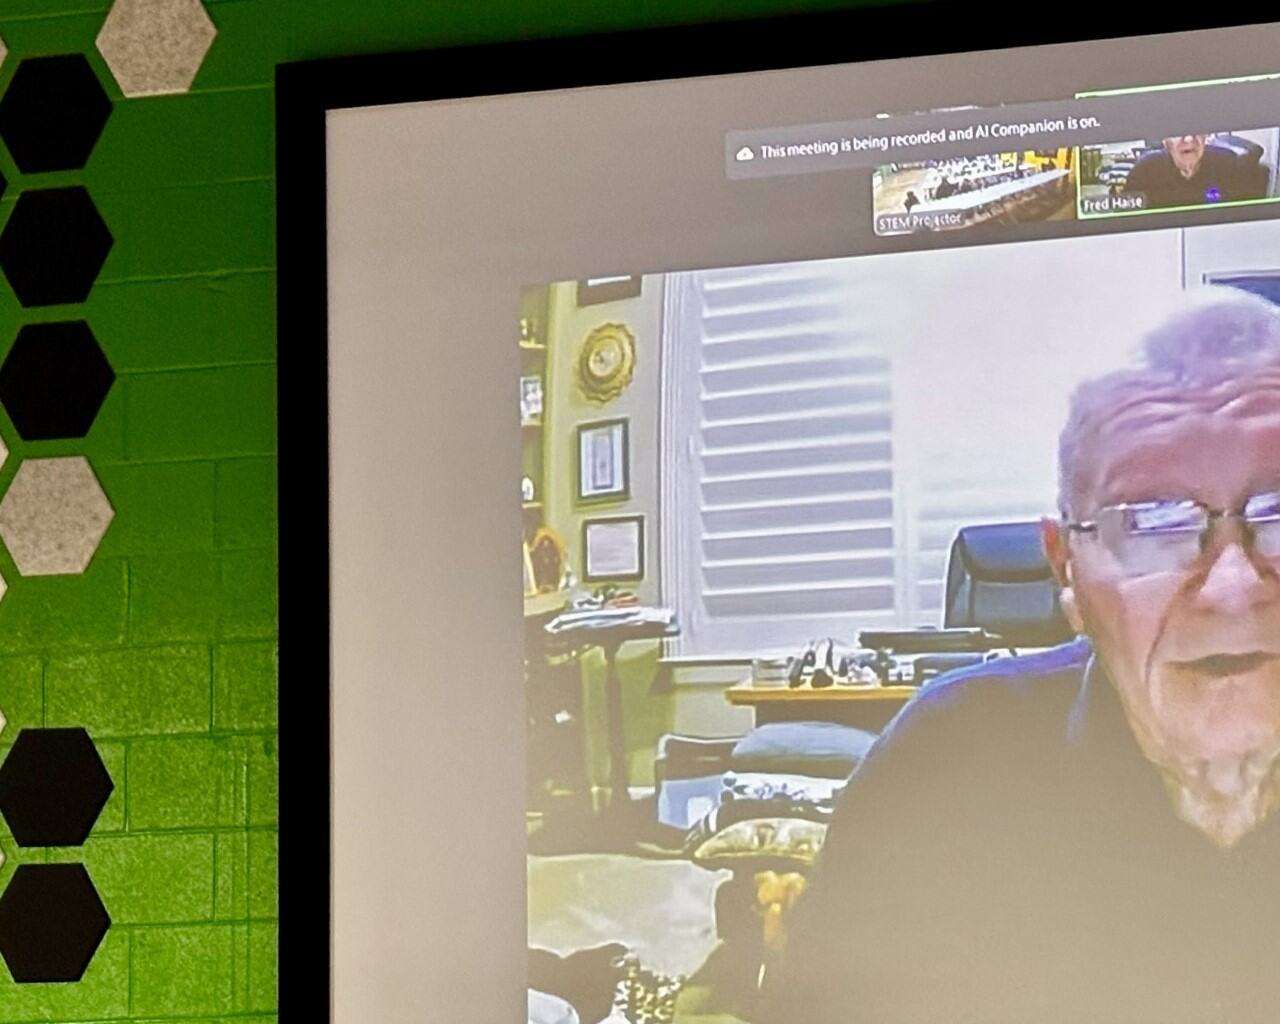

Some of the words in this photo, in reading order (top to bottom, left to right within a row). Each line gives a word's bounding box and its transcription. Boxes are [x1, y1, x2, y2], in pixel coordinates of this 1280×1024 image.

[761, 144, 787, 160] This
[787, 140, 838, 159] meeting
[841, 138, 851, 152] is
[853, 134, 889, 153] being
[890, 128, 946, 146] recorded
[949, 126, 974, 141] and
[975, 124, 989, 139] AI
[990, 118, 1065, 138] Companion
[1067, 116, 1078, 130] is
[1083, 198, 1109, 212] Fred
